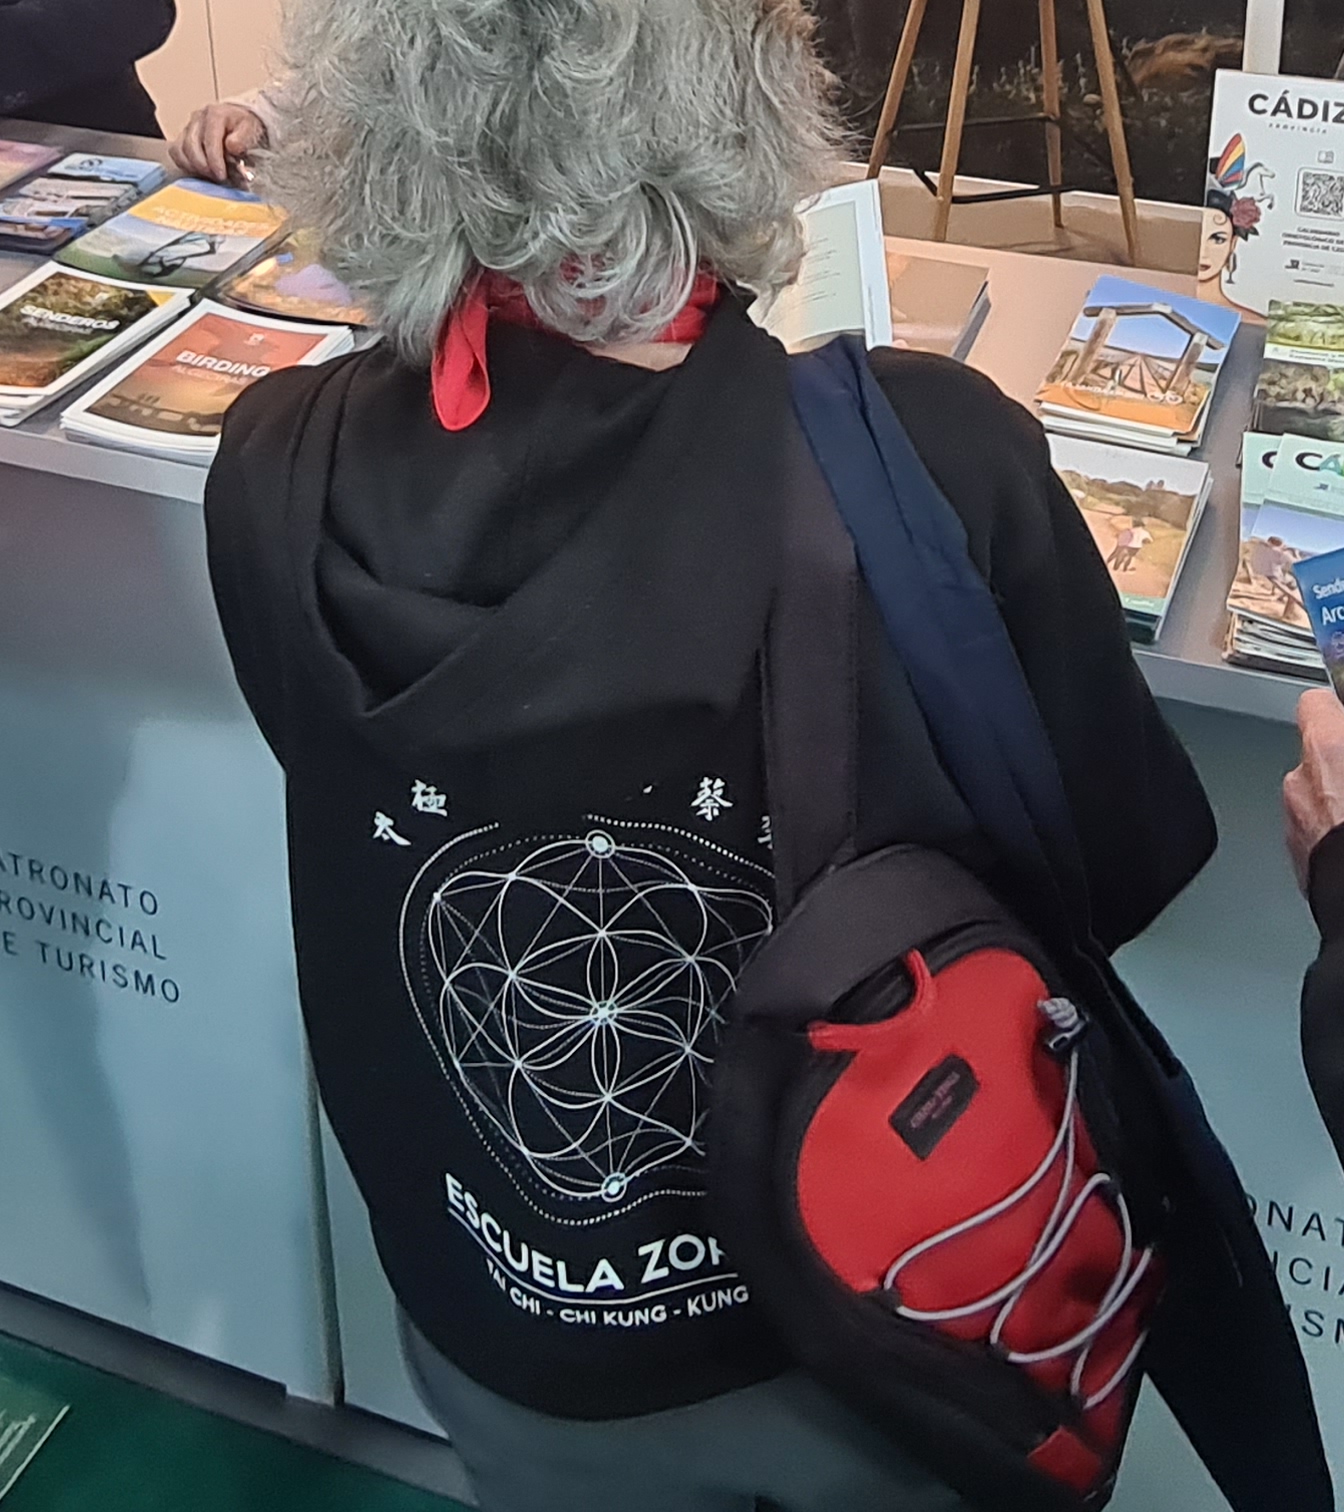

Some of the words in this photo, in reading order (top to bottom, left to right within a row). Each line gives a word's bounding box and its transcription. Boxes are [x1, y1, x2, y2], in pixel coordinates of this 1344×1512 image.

[19, 304, 120, 331] SENDEROS
[175, 350, 271, 377] BIRDING
[35, 940, 181, 1004] TURISMO
[445, 1172, 625, 1293] ESCUELA
[509, 1286, 542, 1316] CHI
[559, 1307, 598, 1325] CHI
[603, 1304, 668, 1327] KUNG
[687, 1285, 750, 1318] KUNG
